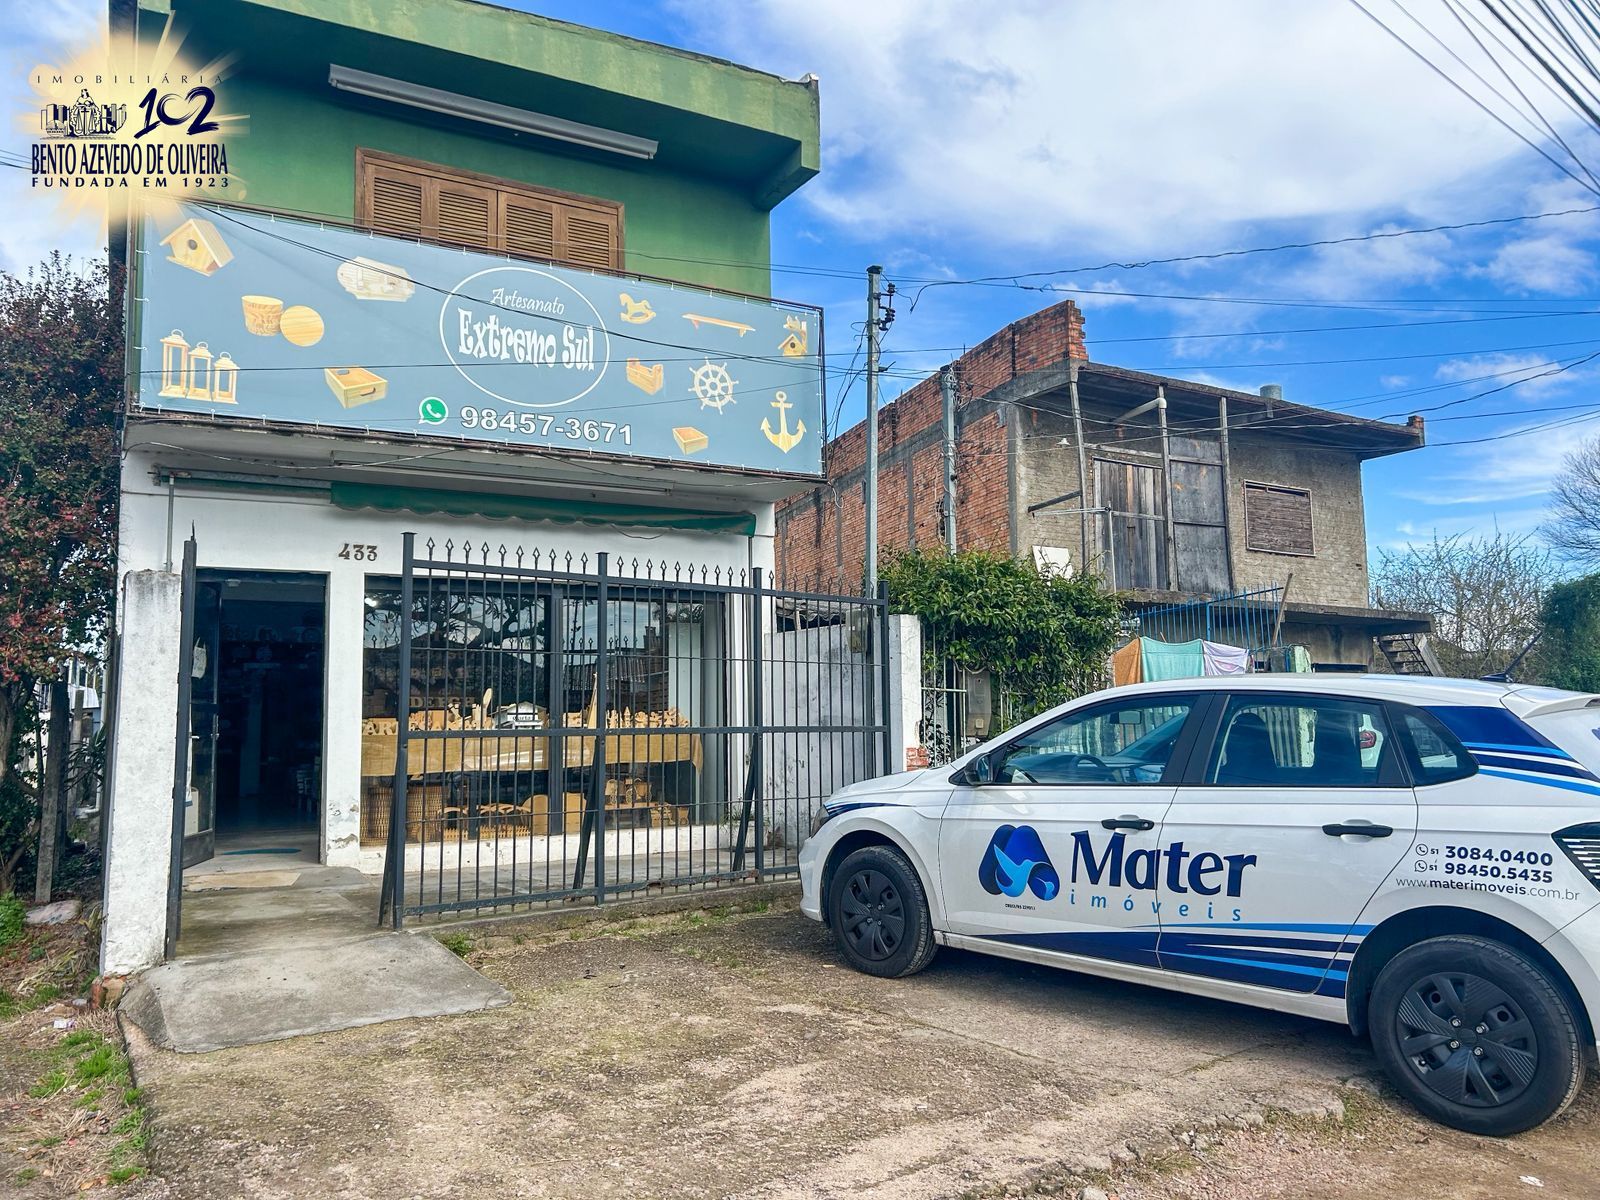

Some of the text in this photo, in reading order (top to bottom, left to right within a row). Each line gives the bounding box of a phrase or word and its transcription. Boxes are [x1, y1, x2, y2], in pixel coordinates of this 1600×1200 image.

[490, 287, 565, 316] Artesanato
[457, 307, 595, 372] Extremo Sul
[460, 406, 632, 445] 98457-3671
[338, 543, 378, 562] 433
[1071, 830, 1257, 898] Mater
[1445, 845, 1553, 867] 3084.0400
[1444, 862, 1553, 884] 98450.5435
[1396, 878, 1581, 901] www.materimoveis.com.br
[1070, 888, 1241, 922] imóveis
